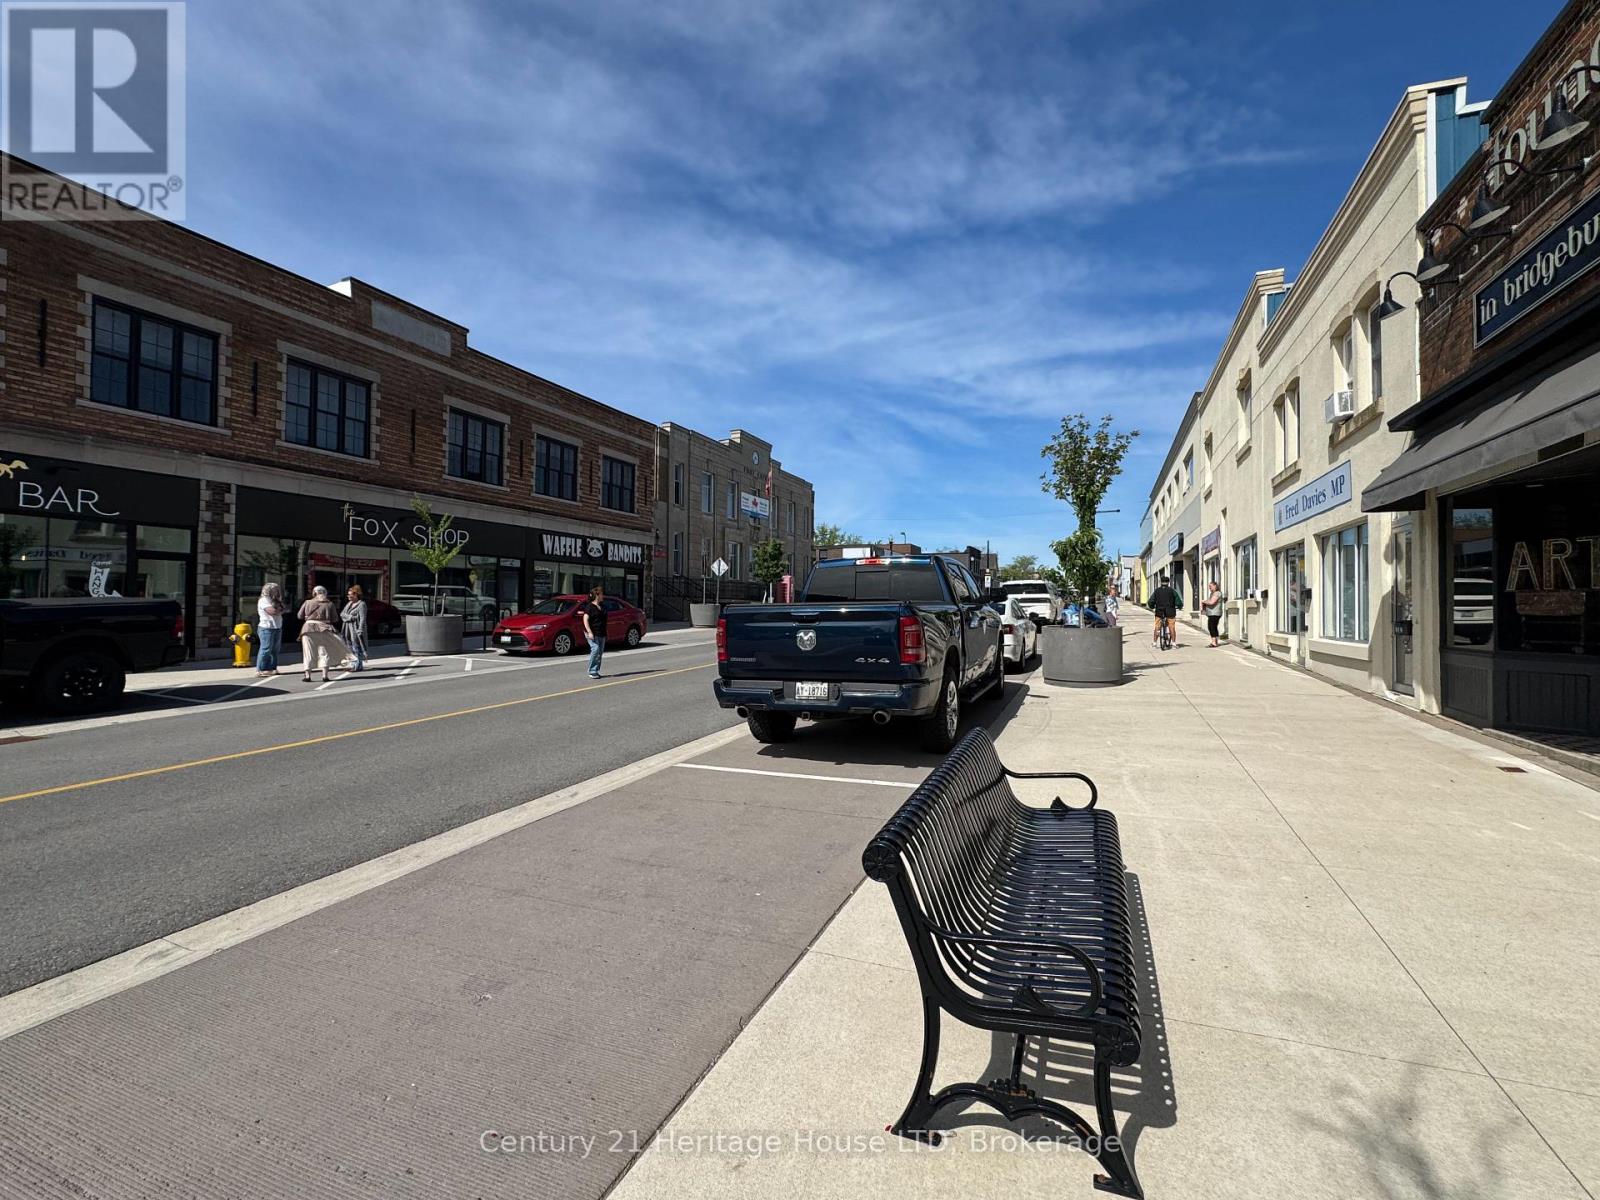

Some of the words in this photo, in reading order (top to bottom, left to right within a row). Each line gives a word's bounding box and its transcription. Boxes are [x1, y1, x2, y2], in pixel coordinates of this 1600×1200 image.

[1480, 297, 1498, 326] in
[18, 481, 120, 516] BAR
[1285, 498, 1299, 521] Fred
[1302, 488, 1327, 512] Davies
[1331, 474, 1345, 498] MP
[348, 516, 399, 546] FOX
[412, 524, 470, 549] SHOP
[542, 533, 583, 558] WAFFLE
[607, 542, 643, 565] BANDITS
